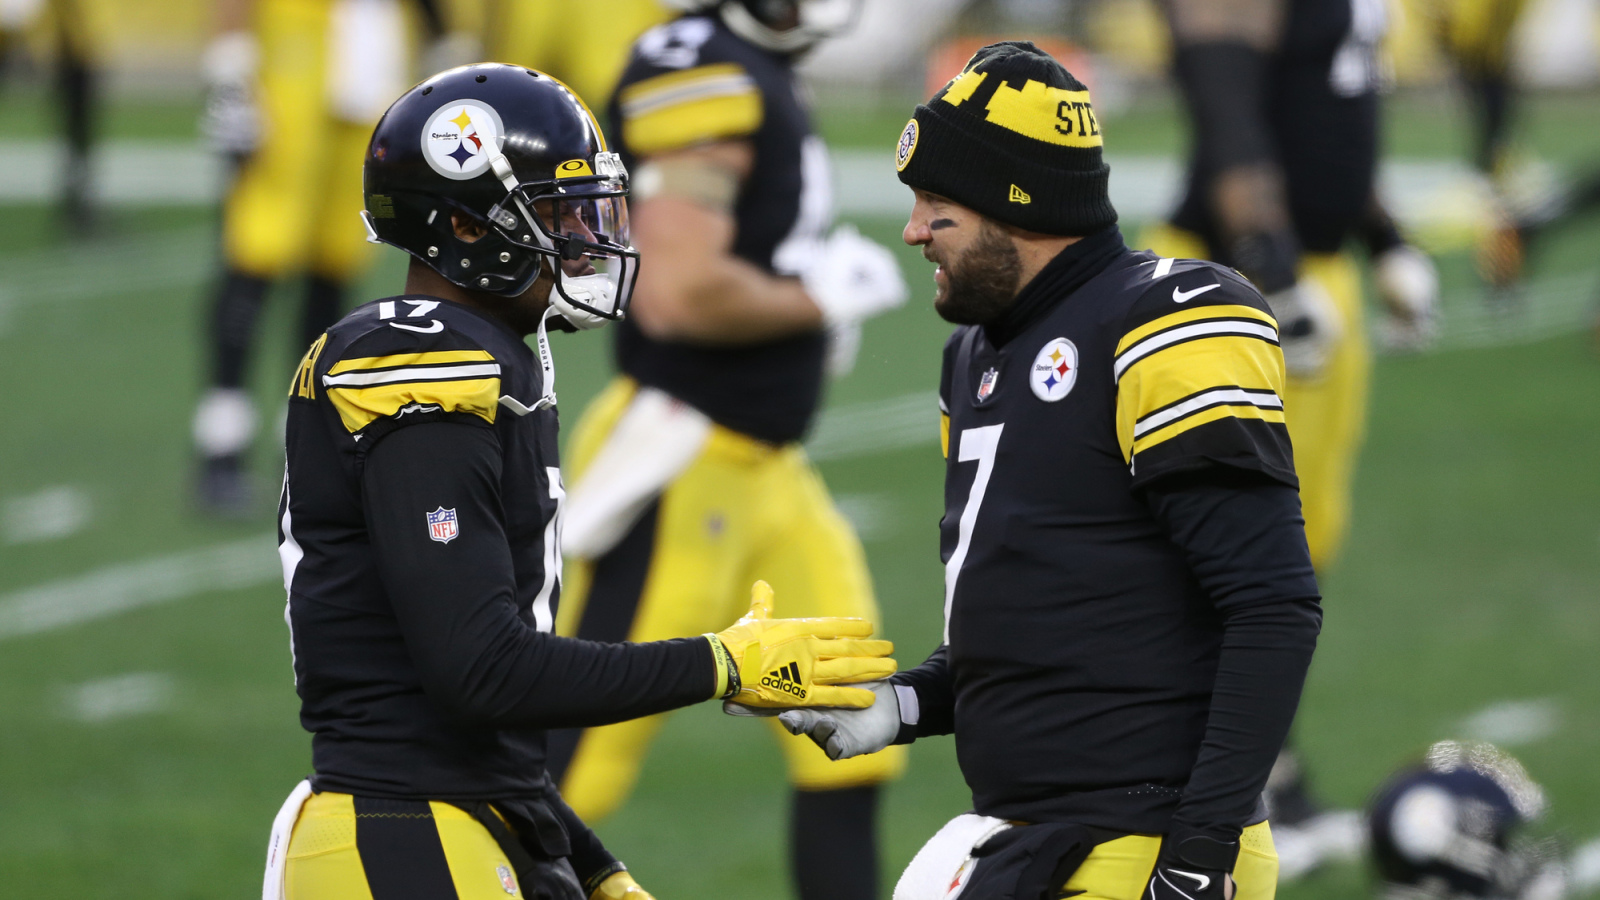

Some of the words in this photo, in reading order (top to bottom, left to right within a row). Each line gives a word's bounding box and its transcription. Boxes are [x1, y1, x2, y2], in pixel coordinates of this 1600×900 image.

[379, 299, 442, 320] 17
[288, 332, 329, 400] ER
[432, 521, 456, 539] NFL
[943, 422, 1005, 646] 7
[761, 675, 807, 699] adidas
